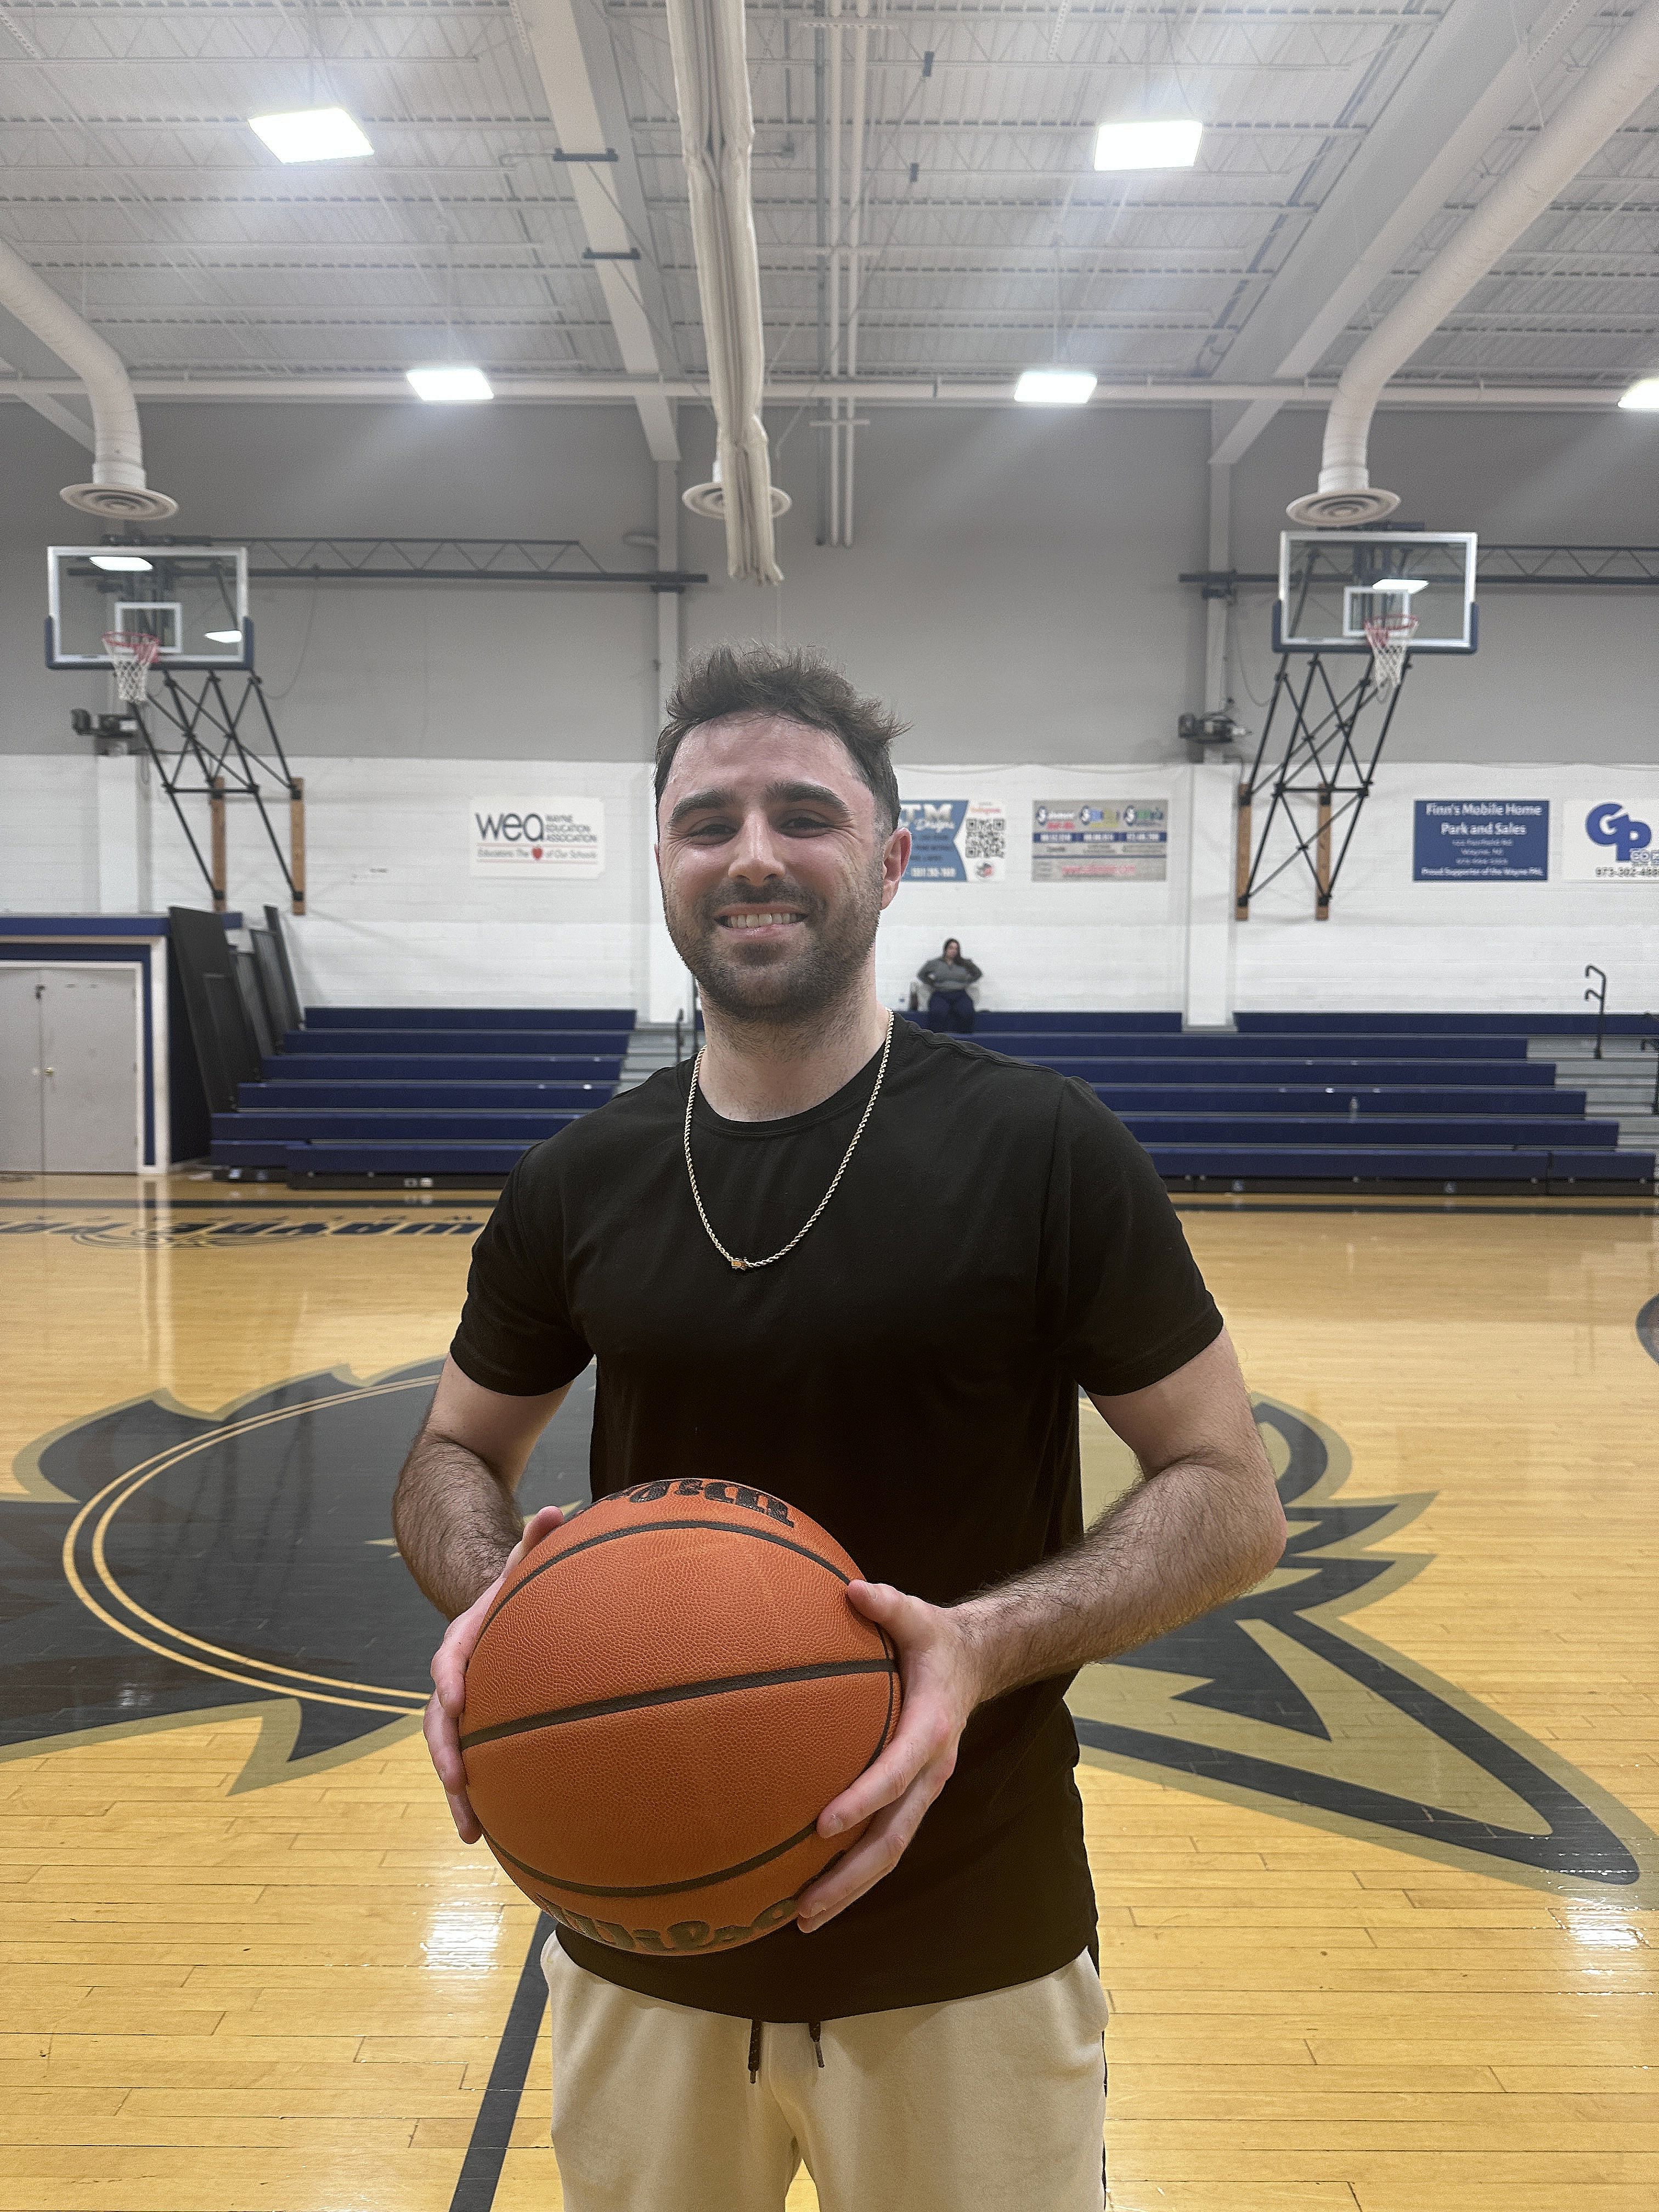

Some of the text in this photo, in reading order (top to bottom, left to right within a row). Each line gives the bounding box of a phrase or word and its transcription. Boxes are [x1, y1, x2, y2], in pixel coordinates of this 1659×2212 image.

[1426, 803, 1542, 816] Finn's Mobile Home
[1441, 822, 1526, 835] Park and Sales
